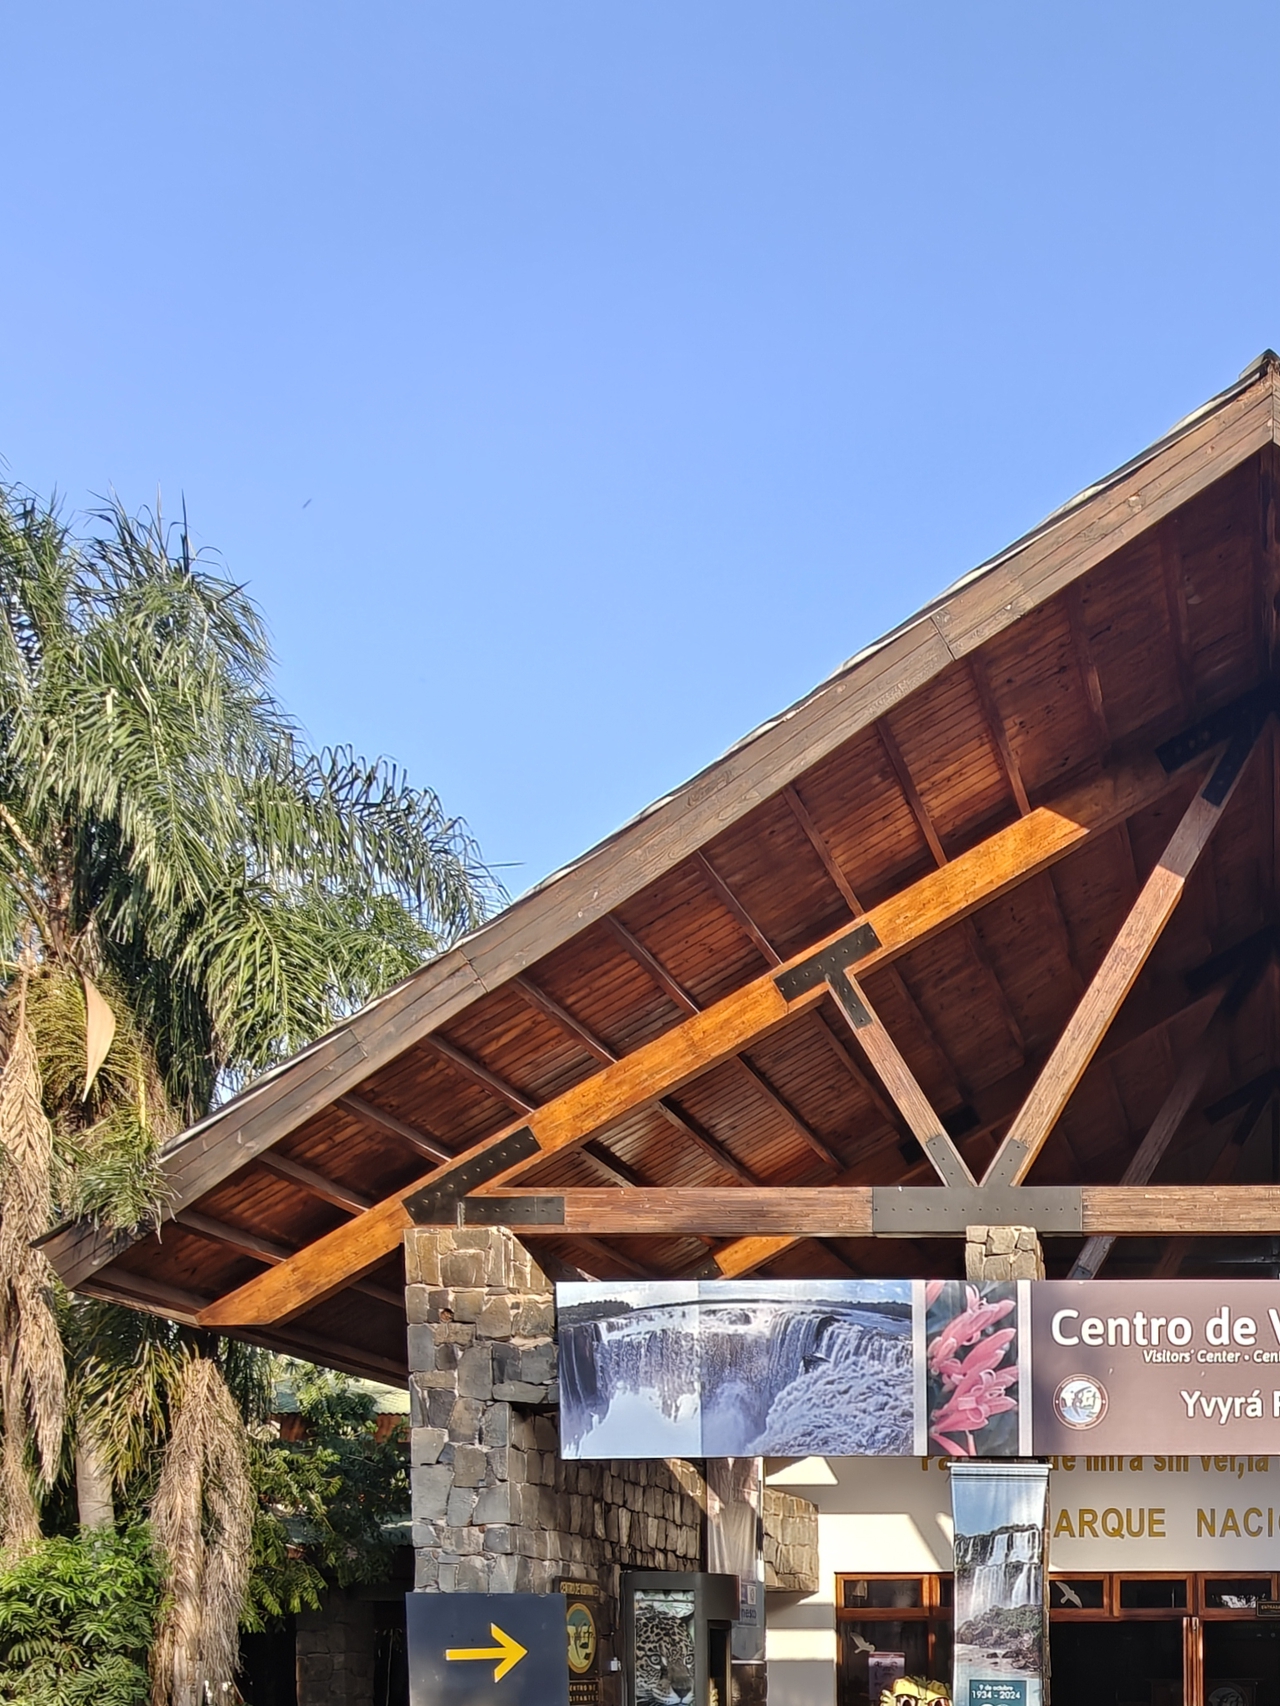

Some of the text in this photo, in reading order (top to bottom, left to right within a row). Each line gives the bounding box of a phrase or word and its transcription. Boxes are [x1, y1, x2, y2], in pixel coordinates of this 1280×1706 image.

[1051, 1309, 1193, 1346] Centro
[1205, 1306, 1257, 1346] de
[1197, 1350, 1241, 1363] Center
[1180, 1390, 1263, 1425] Yvyrá
[1053, 1508, 1166, 1539] ARQUE
[972, 1690, 992, 1698] 1934
[999, 1691, 1020, 1699] 2024
